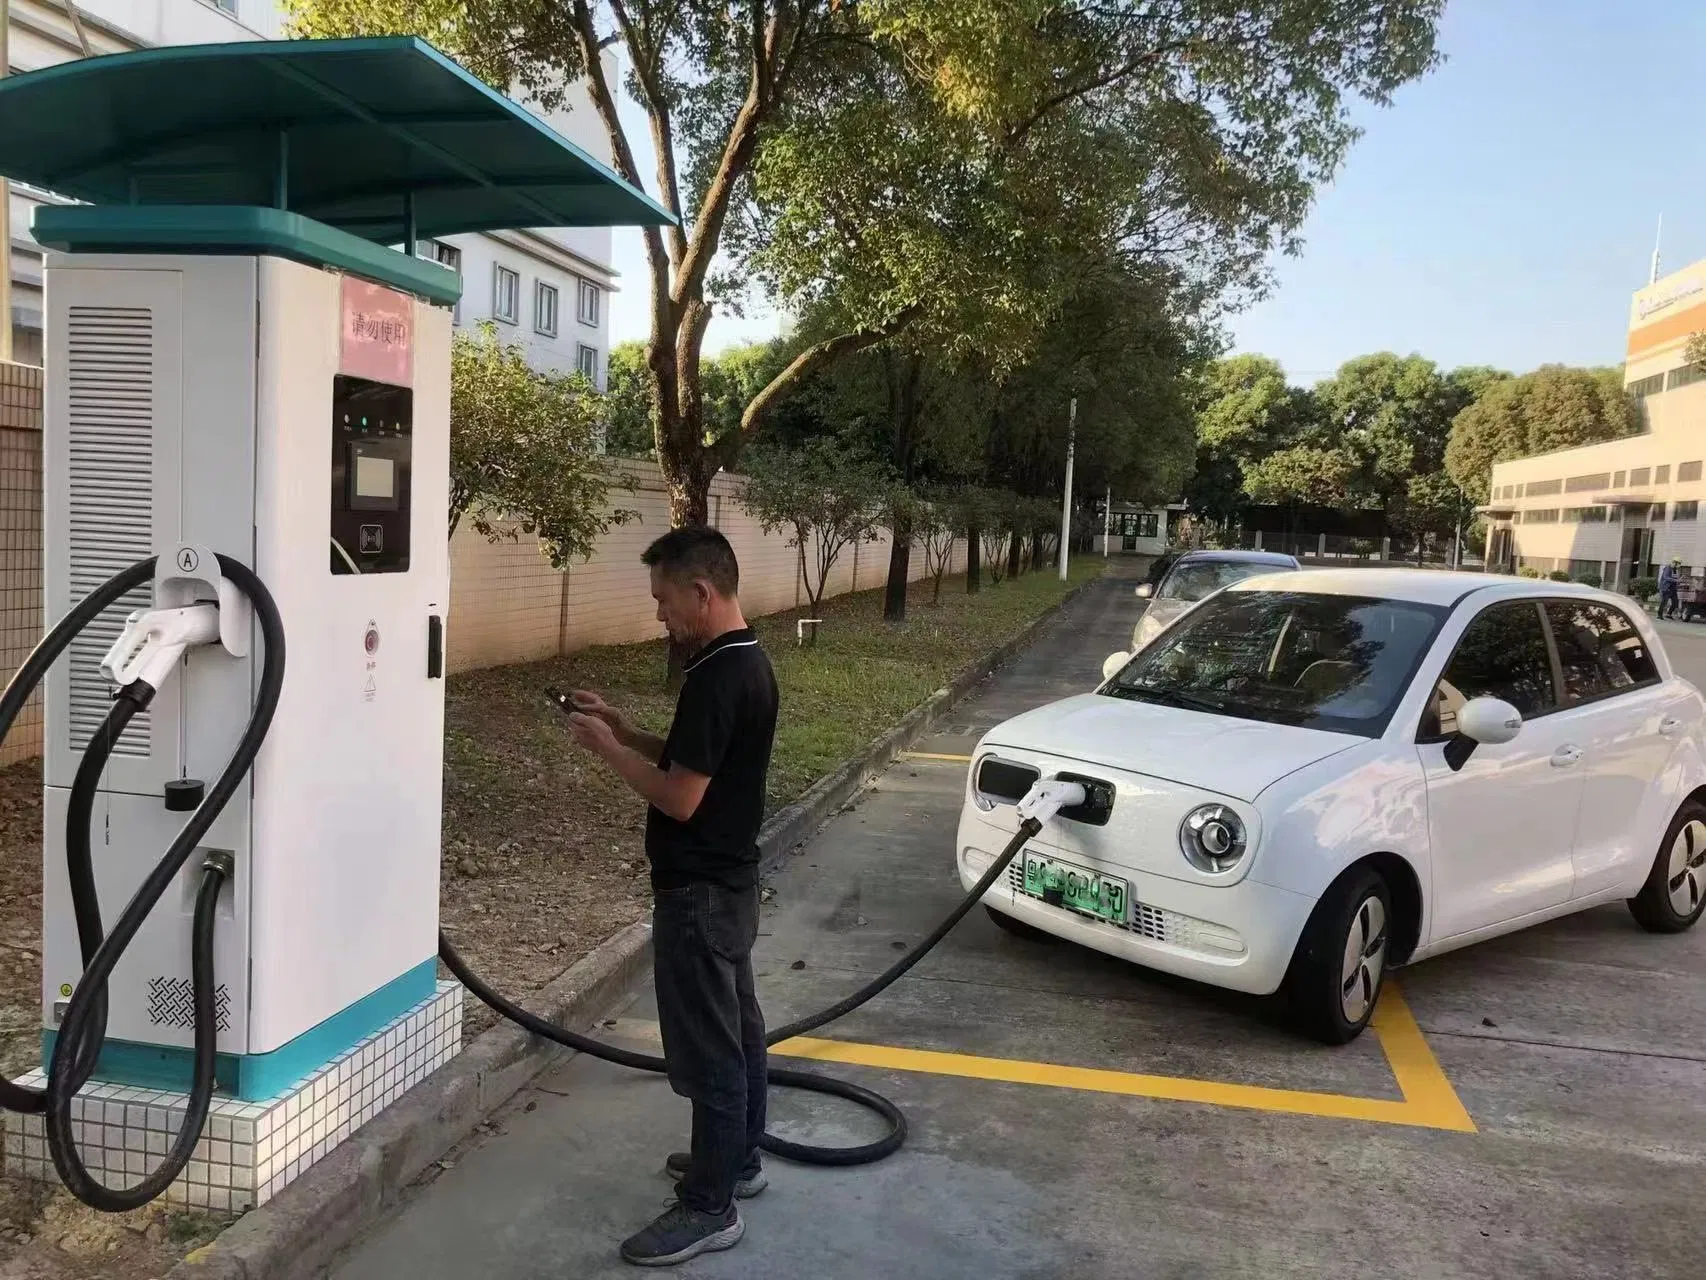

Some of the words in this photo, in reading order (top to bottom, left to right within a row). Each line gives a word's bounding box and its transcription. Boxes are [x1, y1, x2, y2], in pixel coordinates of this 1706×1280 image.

[352, 312, 406, 346] 请勿使用
[183, 552, 193, 568] A
